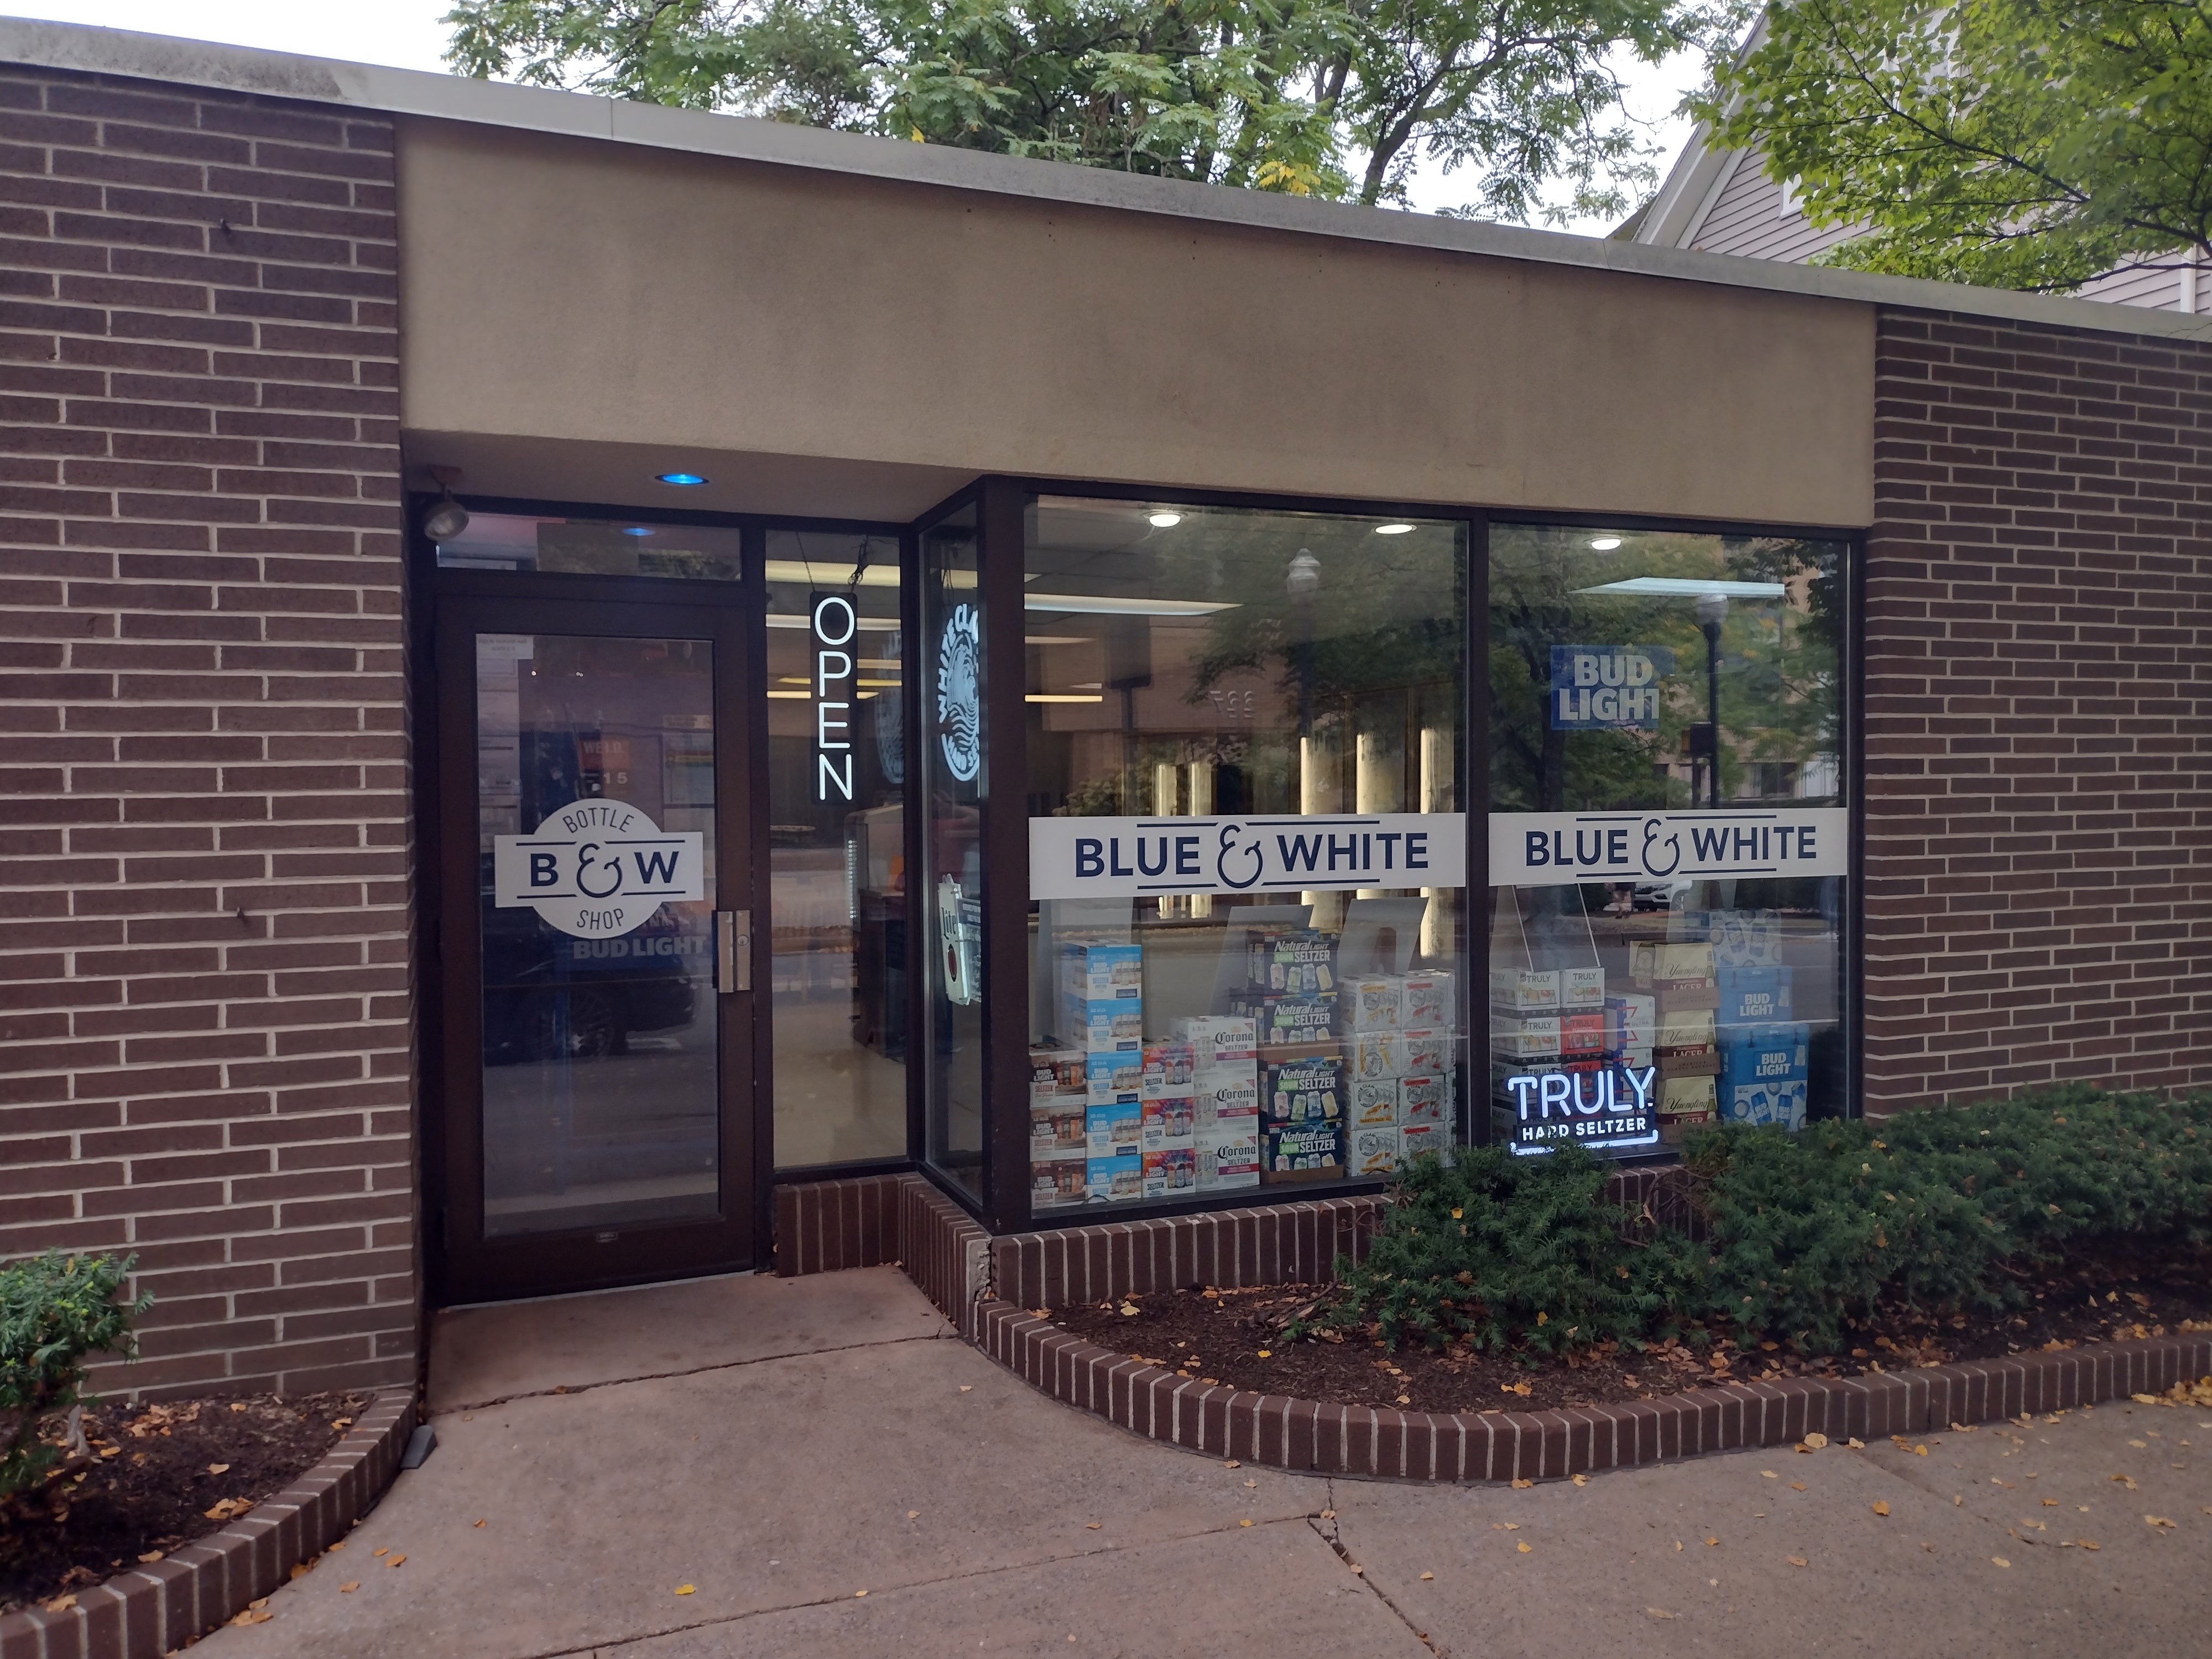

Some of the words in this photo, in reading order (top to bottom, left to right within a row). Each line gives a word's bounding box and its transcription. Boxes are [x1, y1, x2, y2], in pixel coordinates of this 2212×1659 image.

[1574, 655, 1653, 686] BUD
[815, 597, 855, 800] OPEN
[562, 807, 634, 833] BOTTLE
[1526, 829, 1629, 867] BLUE
[1642, 818, 1680, 877] &
[1691, 826, 1817, 862] WHITE
[1076, 836, 1201, 878] BLUE
[1217, 824, 1263, 889] &
[1276, 832, 1428, 872] WHITE
[530, 853, 559, 886] B
[577, 843, 623, 898] &
[634, 851, 680, 884] W
[577, 909, 624, 930] SHOP
[573, 939, 629, 959] BUD
[632, 936, 707, 957] LIGHT
[1274, 940, 1311, 952] Natural
[1294, 950, 1331, 963] SELTZER
[1573, 972, 1597, 980] TRULY
[1665, 963, 1707, 978] Yuengling
[1744, 993, 1770, 1005] BUD
[1274, 1003, 1312, 1016] Natural
[1740, 1004, 1775, 1017] LIGHT
[1295, 1013, 1331, 1026] SELTZER
[1528, 1021, 1552, 1030] TRULY
[1572, 1019, 1595, 1027] TRULY
[1215, 1031, 1254, 1046] Corona
[1664, 1030, 1707, 1045] Yuengling
[1761, 1052, 1787, 1065] BUD
[1279, 1067, 1317, 1079] Natural
[1756, 1063, 1791, 1077] LIGHT
[1300, 1077, 1336, 1090] SELTZER
[1216, 1088, 1255, 1103] Corona
[1666, 1097, 1708, 1112] Yuengling
[1576, 1117, 1646, 1136] SELTZER
[1280, 1130, 1317, 1143] Natural
[1300, 1139, 1336, 1152] SELTZER
[1218, 1146, 1256, 1160] Corona
